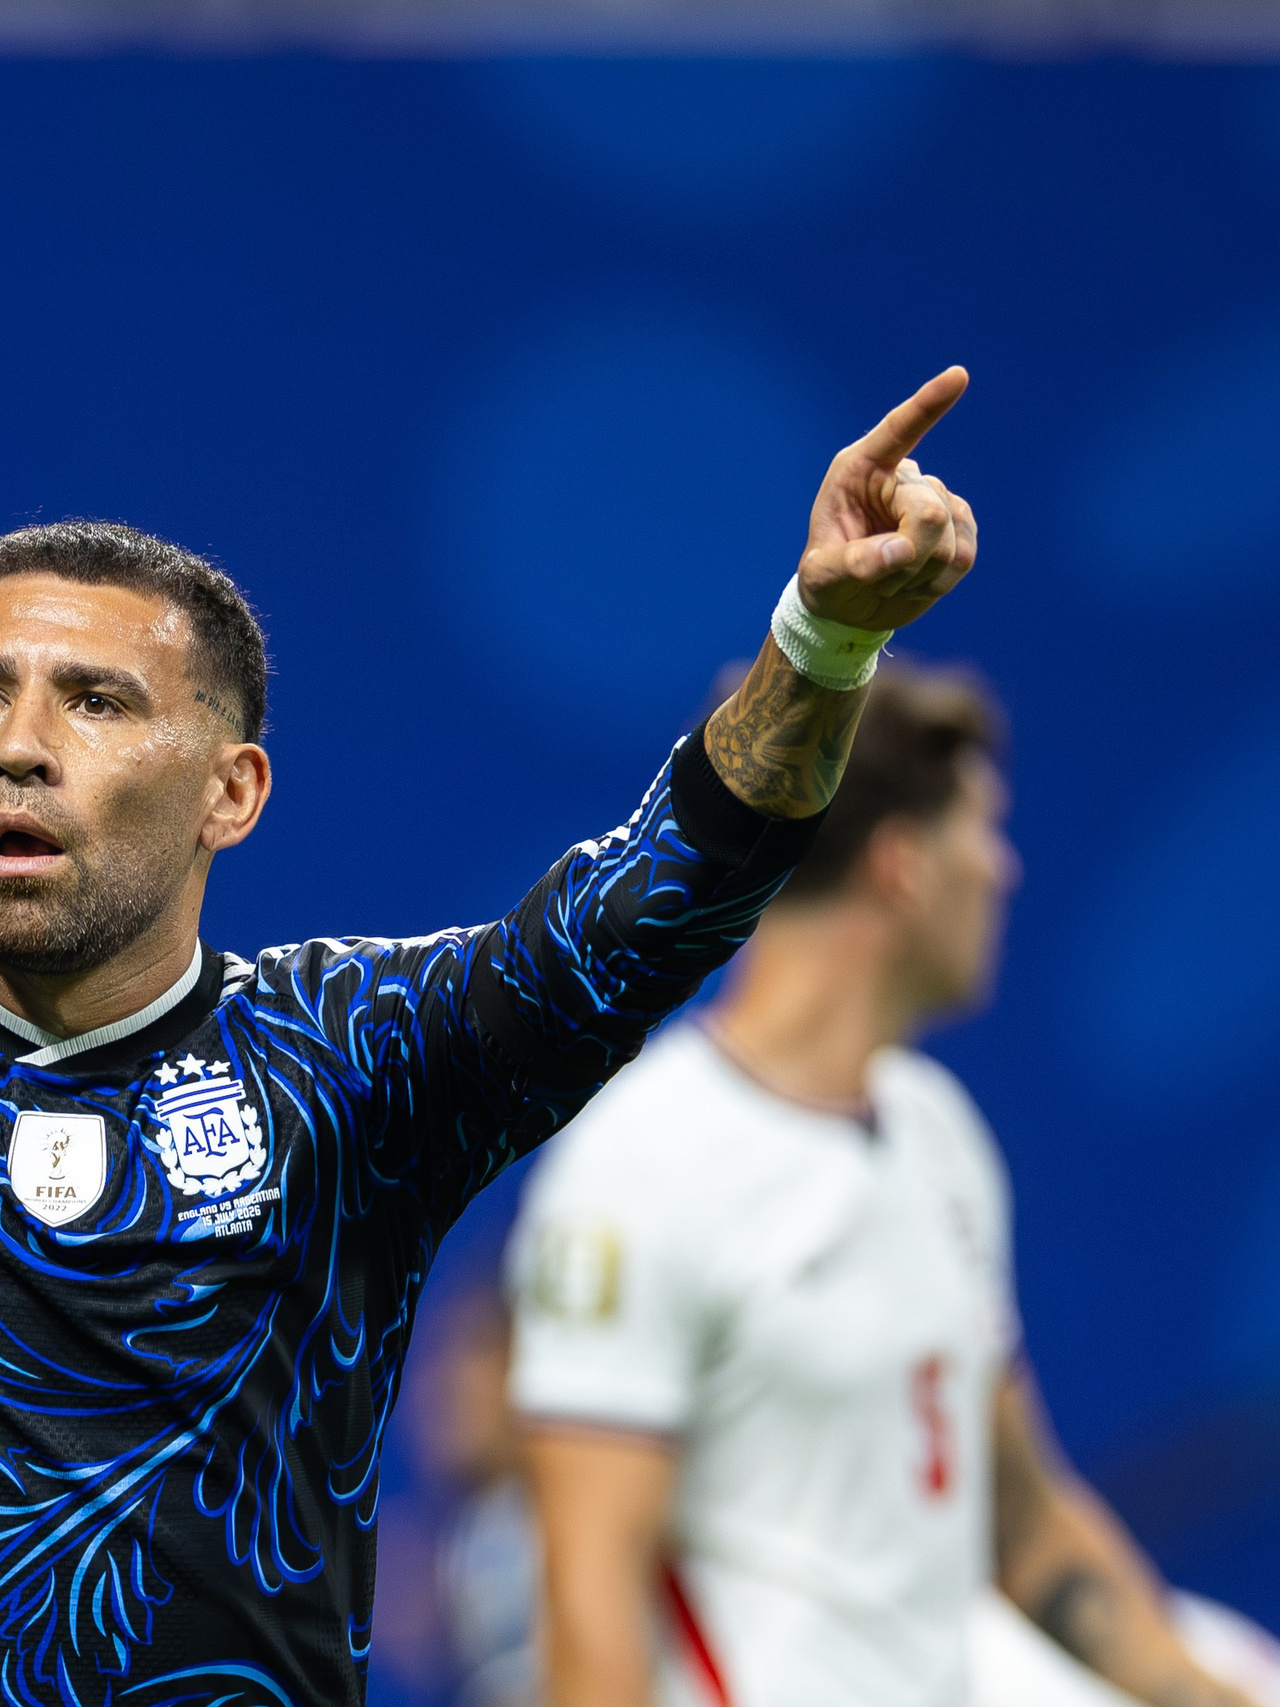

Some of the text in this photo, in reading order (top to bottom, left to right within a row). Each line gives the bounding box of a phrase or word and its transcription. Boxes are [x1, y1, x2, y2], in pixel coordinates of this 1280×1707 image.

[183, 1107, 240, 1158] AFA
[36, 1186, 77, 1198] FIFA
[42, 1204, 67, 1212] 2022
[177, 1204, 218, 1222] ENGLAND
[233, 1187, 281, 1209] ARGENTINA
[202, 1204, 262, 1226] 15 JULY 2026
[214, 1219, 253, 1238] ATLANTA
